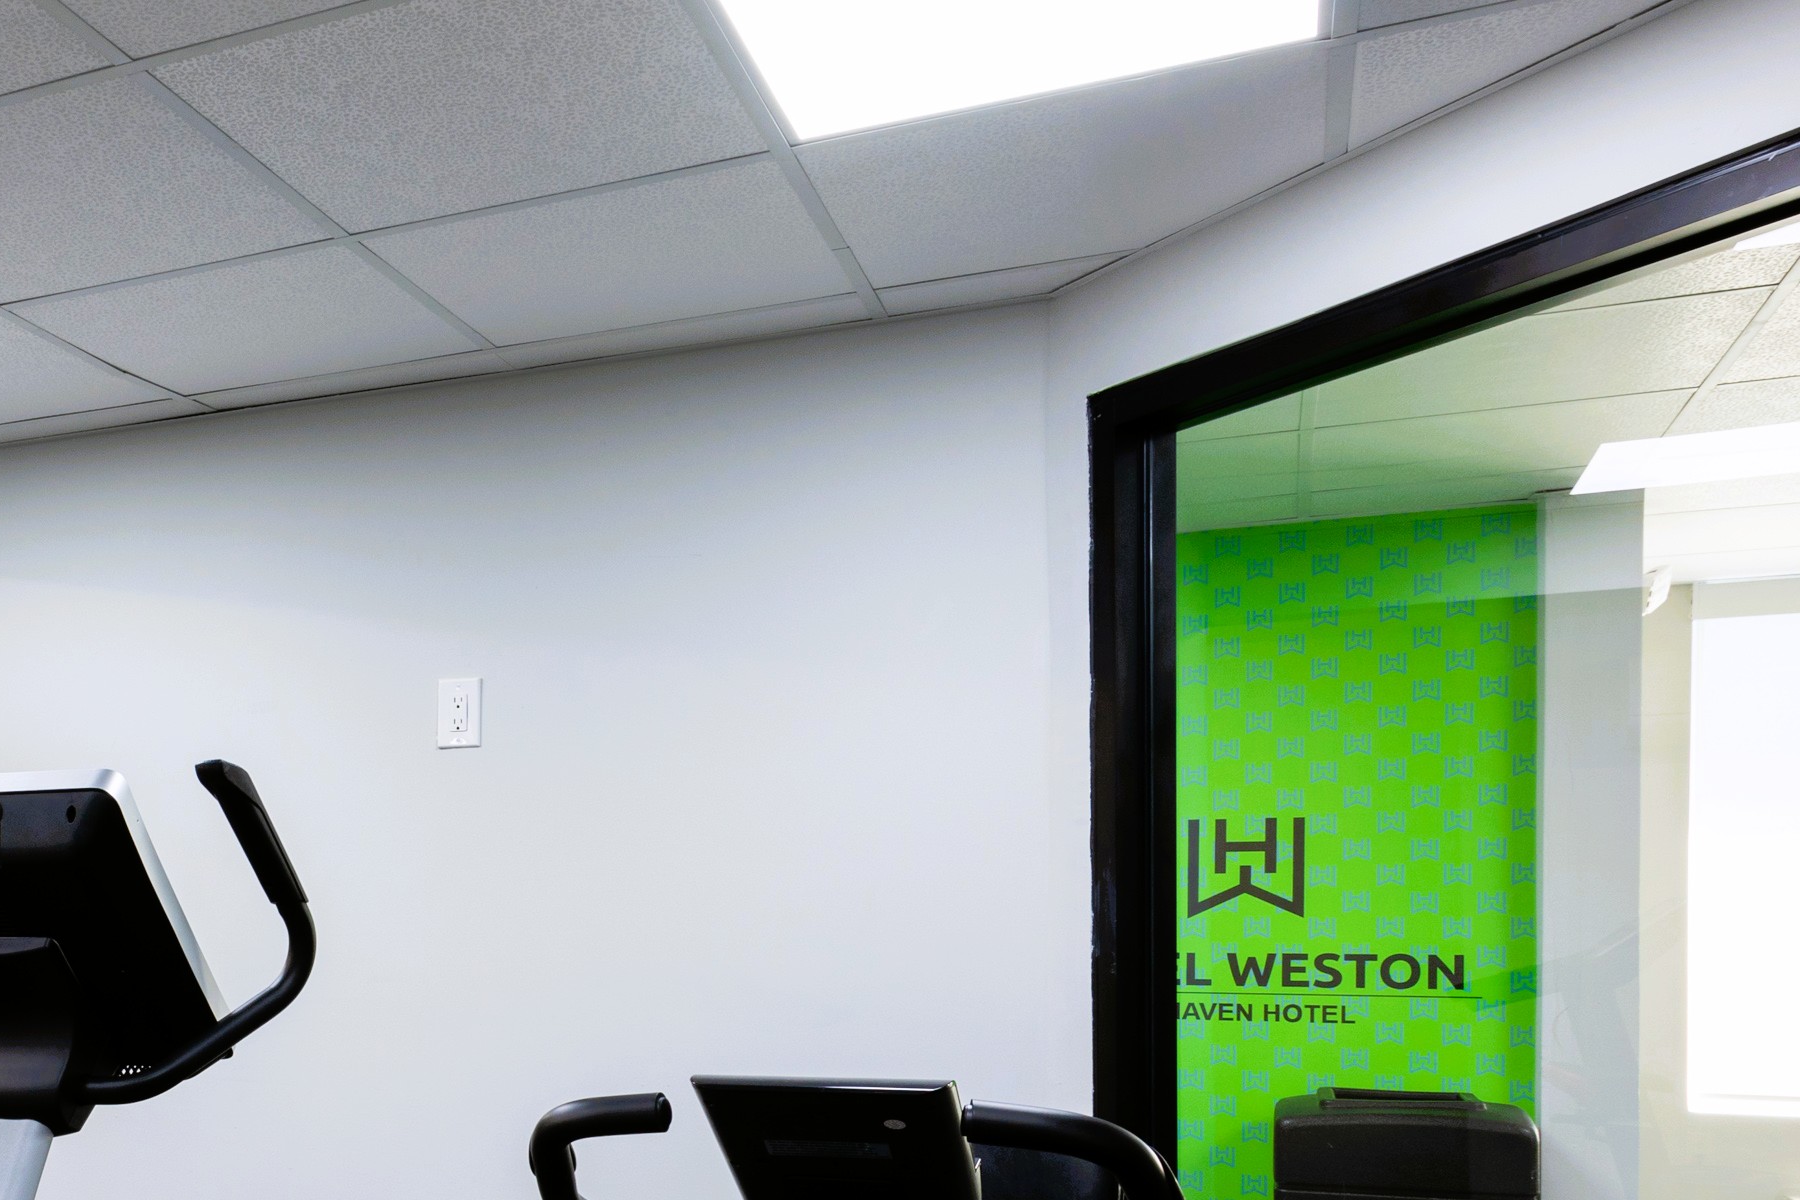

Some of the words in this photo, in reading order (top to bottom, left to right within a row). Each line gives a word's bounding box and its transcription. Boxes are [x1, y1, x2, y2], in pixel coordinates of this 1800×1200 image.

[1227, 952, 1465, 990] WESTON
[1177, 1002, 1253, 1022] AVEN
[1263, 1003, 1356, 1024] HOTEL
